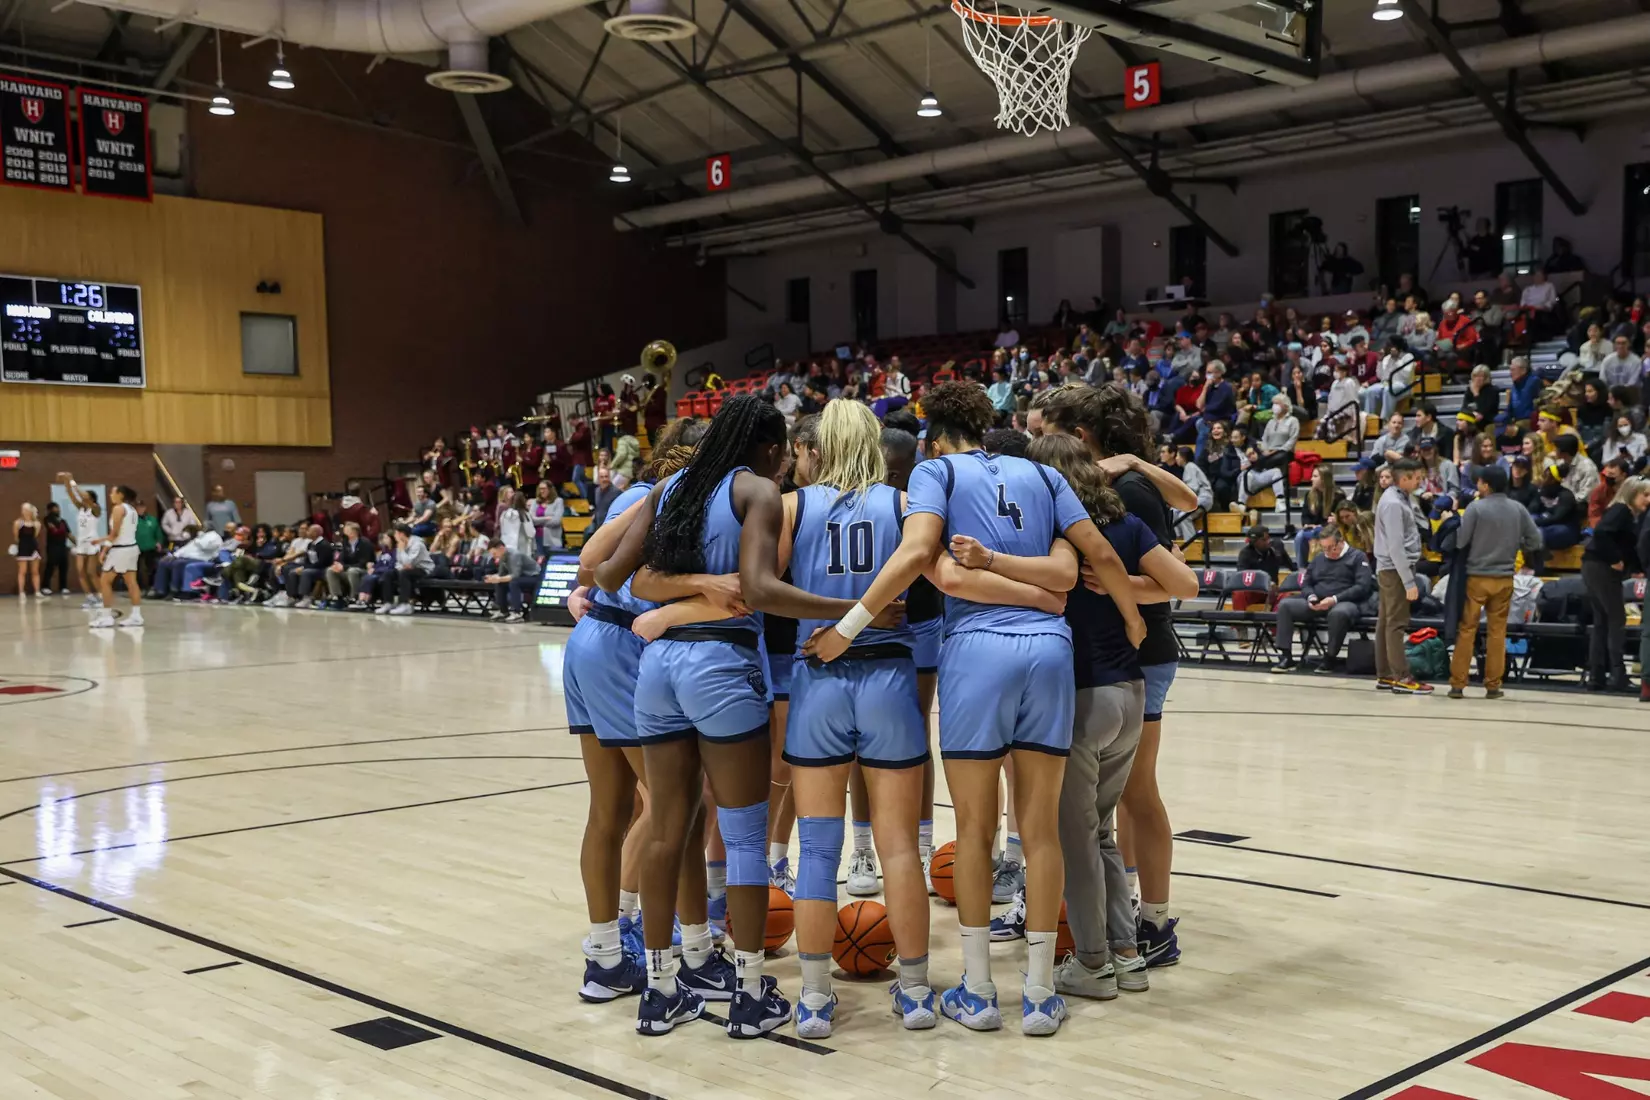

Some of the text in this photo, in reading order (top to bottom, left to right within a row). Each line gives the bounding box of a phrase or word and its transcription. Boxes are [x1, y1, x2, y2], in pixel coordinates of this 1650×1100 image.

[0, 80, 63, 100] HARVARD
[1133, 68, 1150, 102] 5
[27, 100, 39, 117] H
[83, 94, 142, 113] HARVARD
[108, 112, 120, 129] H
[14, 126, 55, 146] WNIT
[96, 138, 135, 157] WNIT
[87, 156, 115, 168] 2017
[711, 160, 723, 186] 6
[61, 283, 103, 308] 1:26
[58, 313, 85, 324] PERIOD
[3, 341, 28, 351] FOULS
[50, 344, 98, 356] PLAYER FOUL
[117, 349, 141, 358] FOULS
[62, 373, 88, 383] MATCH
[996, 482, 1024, 532] 4
[826, 520, 875, 576] 10
